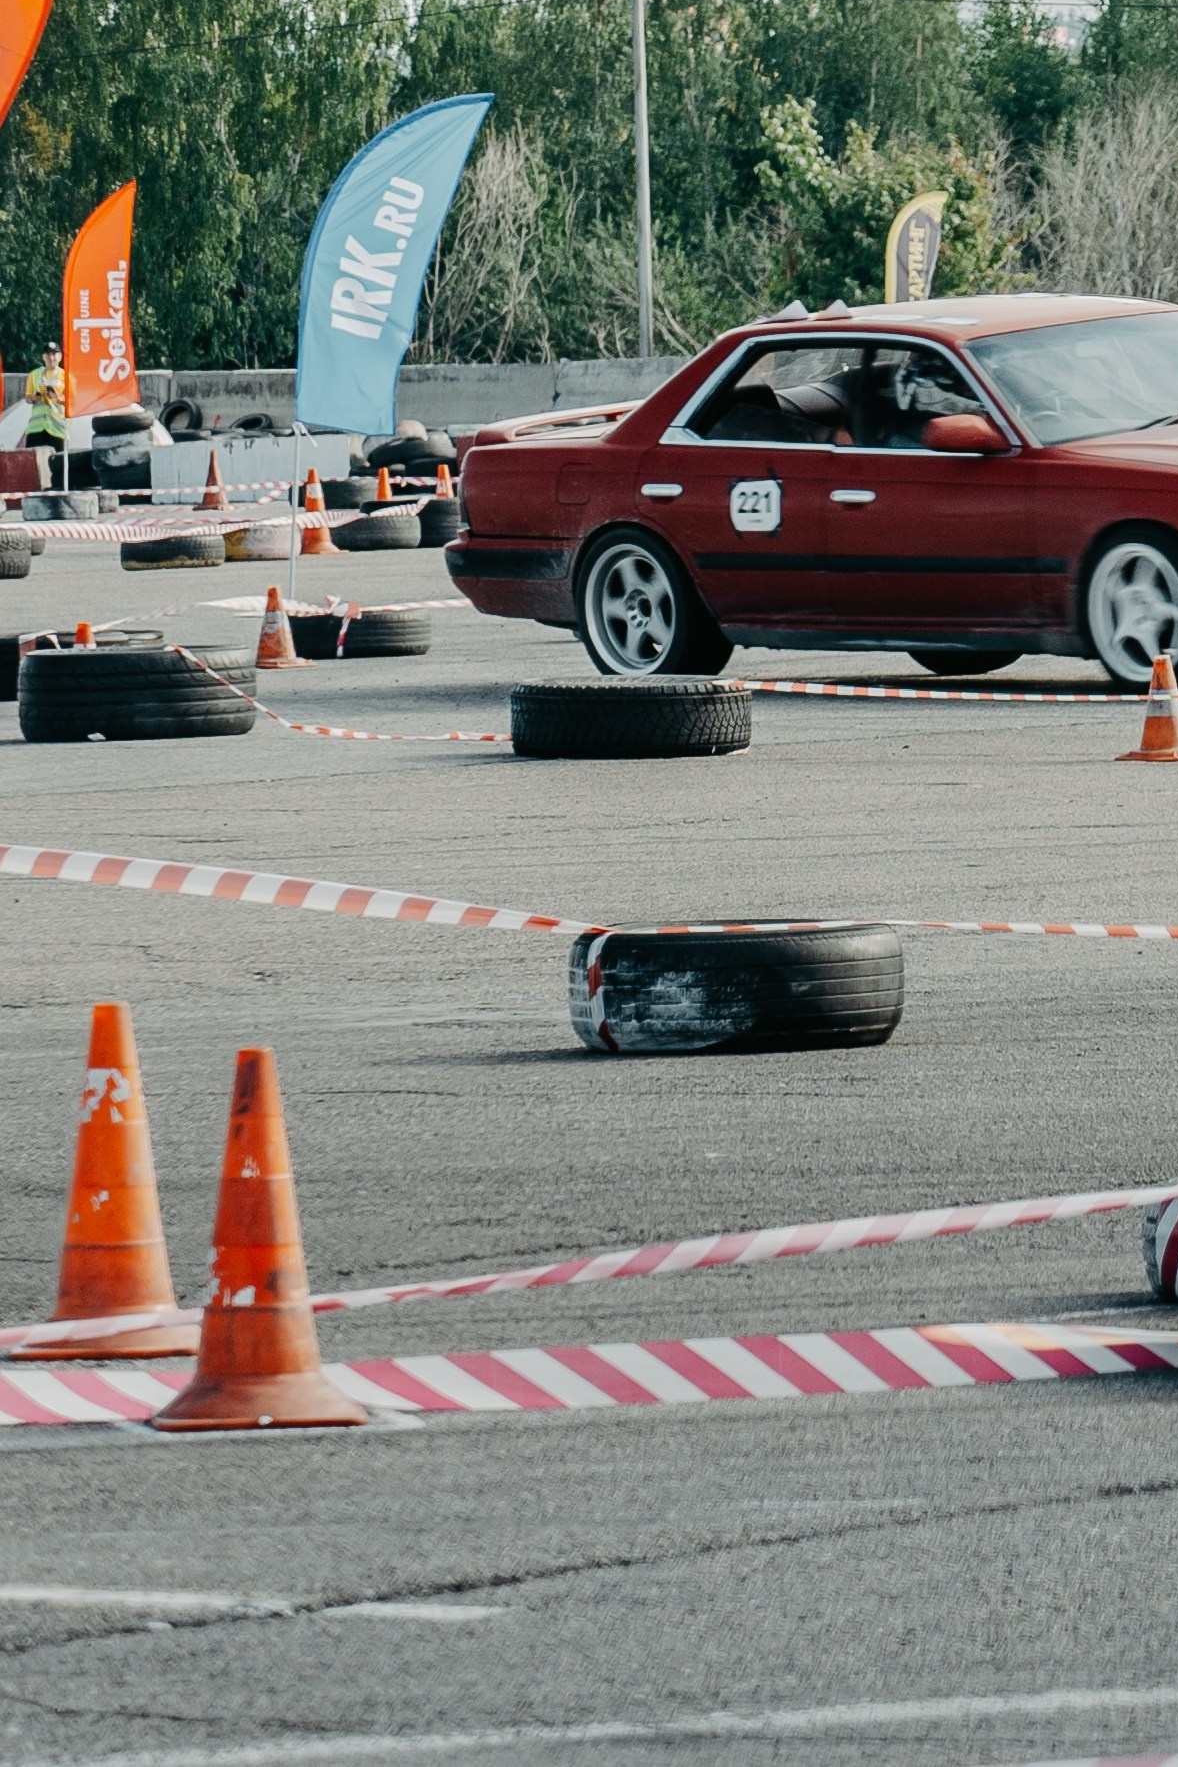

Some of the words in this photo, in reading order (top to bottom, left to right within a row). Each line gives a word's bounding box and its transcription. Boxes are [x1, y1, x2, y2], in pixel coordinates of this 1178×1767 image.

[331, 176, 425, 340] IRK.RU
[79, 289, 91, 354] GENUINE
[737, 491, 772, 514] 221
